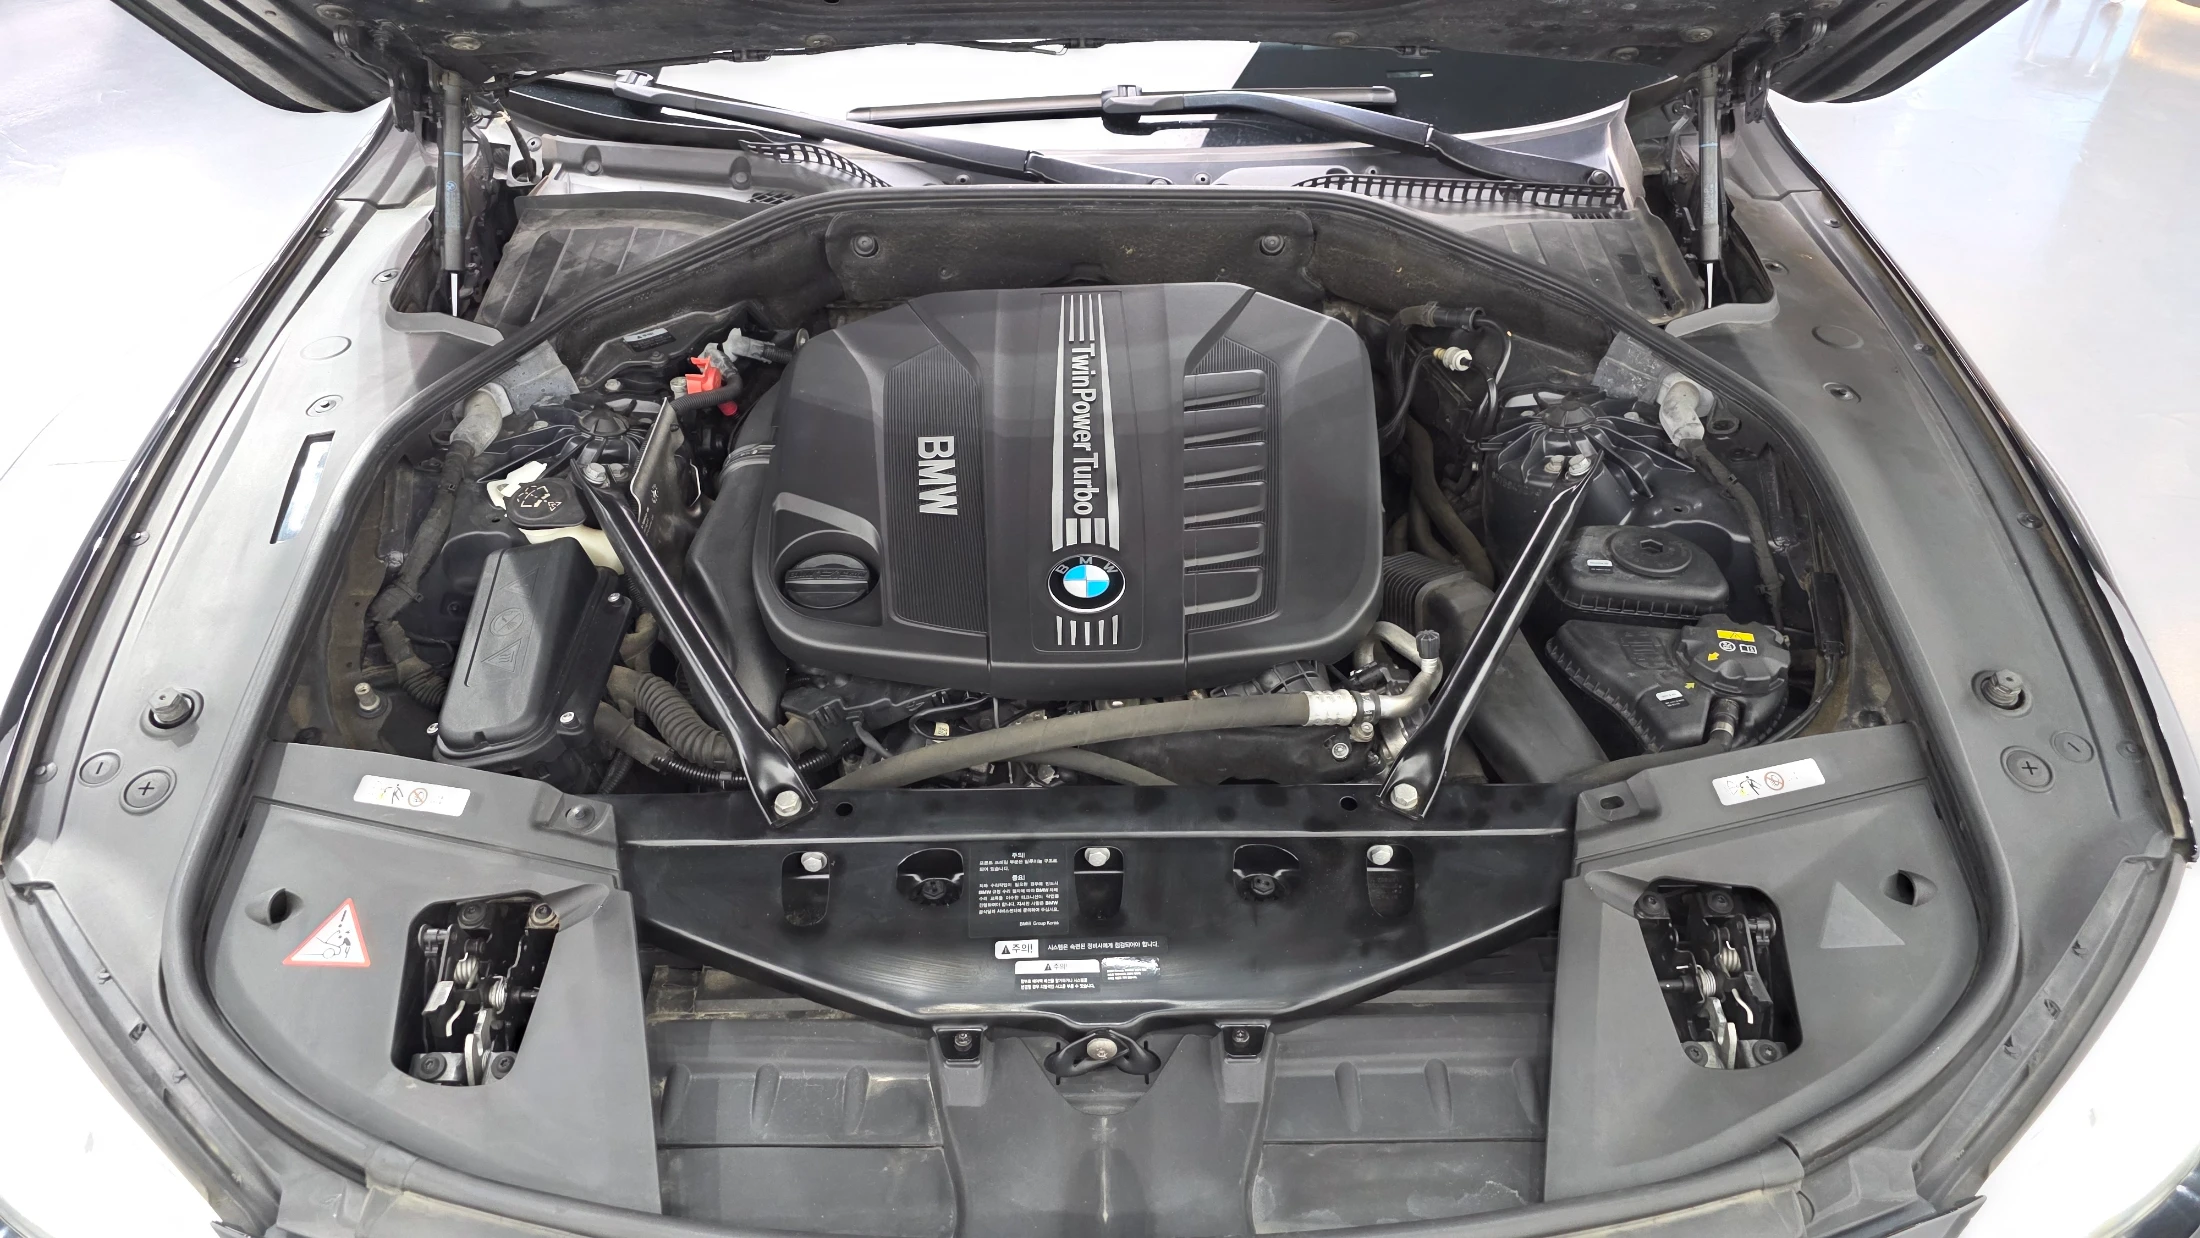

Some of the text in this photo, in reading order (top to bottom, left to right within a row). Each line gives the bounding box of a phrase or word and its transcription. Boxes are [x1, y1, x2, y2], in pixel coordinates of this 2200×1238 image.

[1071, 342, 1098, 515] TwinPower Turbo
[917, 435, 958, 516] BMW
[1055, 555, 1118, 575] BMW
[1012, 944, 1033, 953] 주의!
